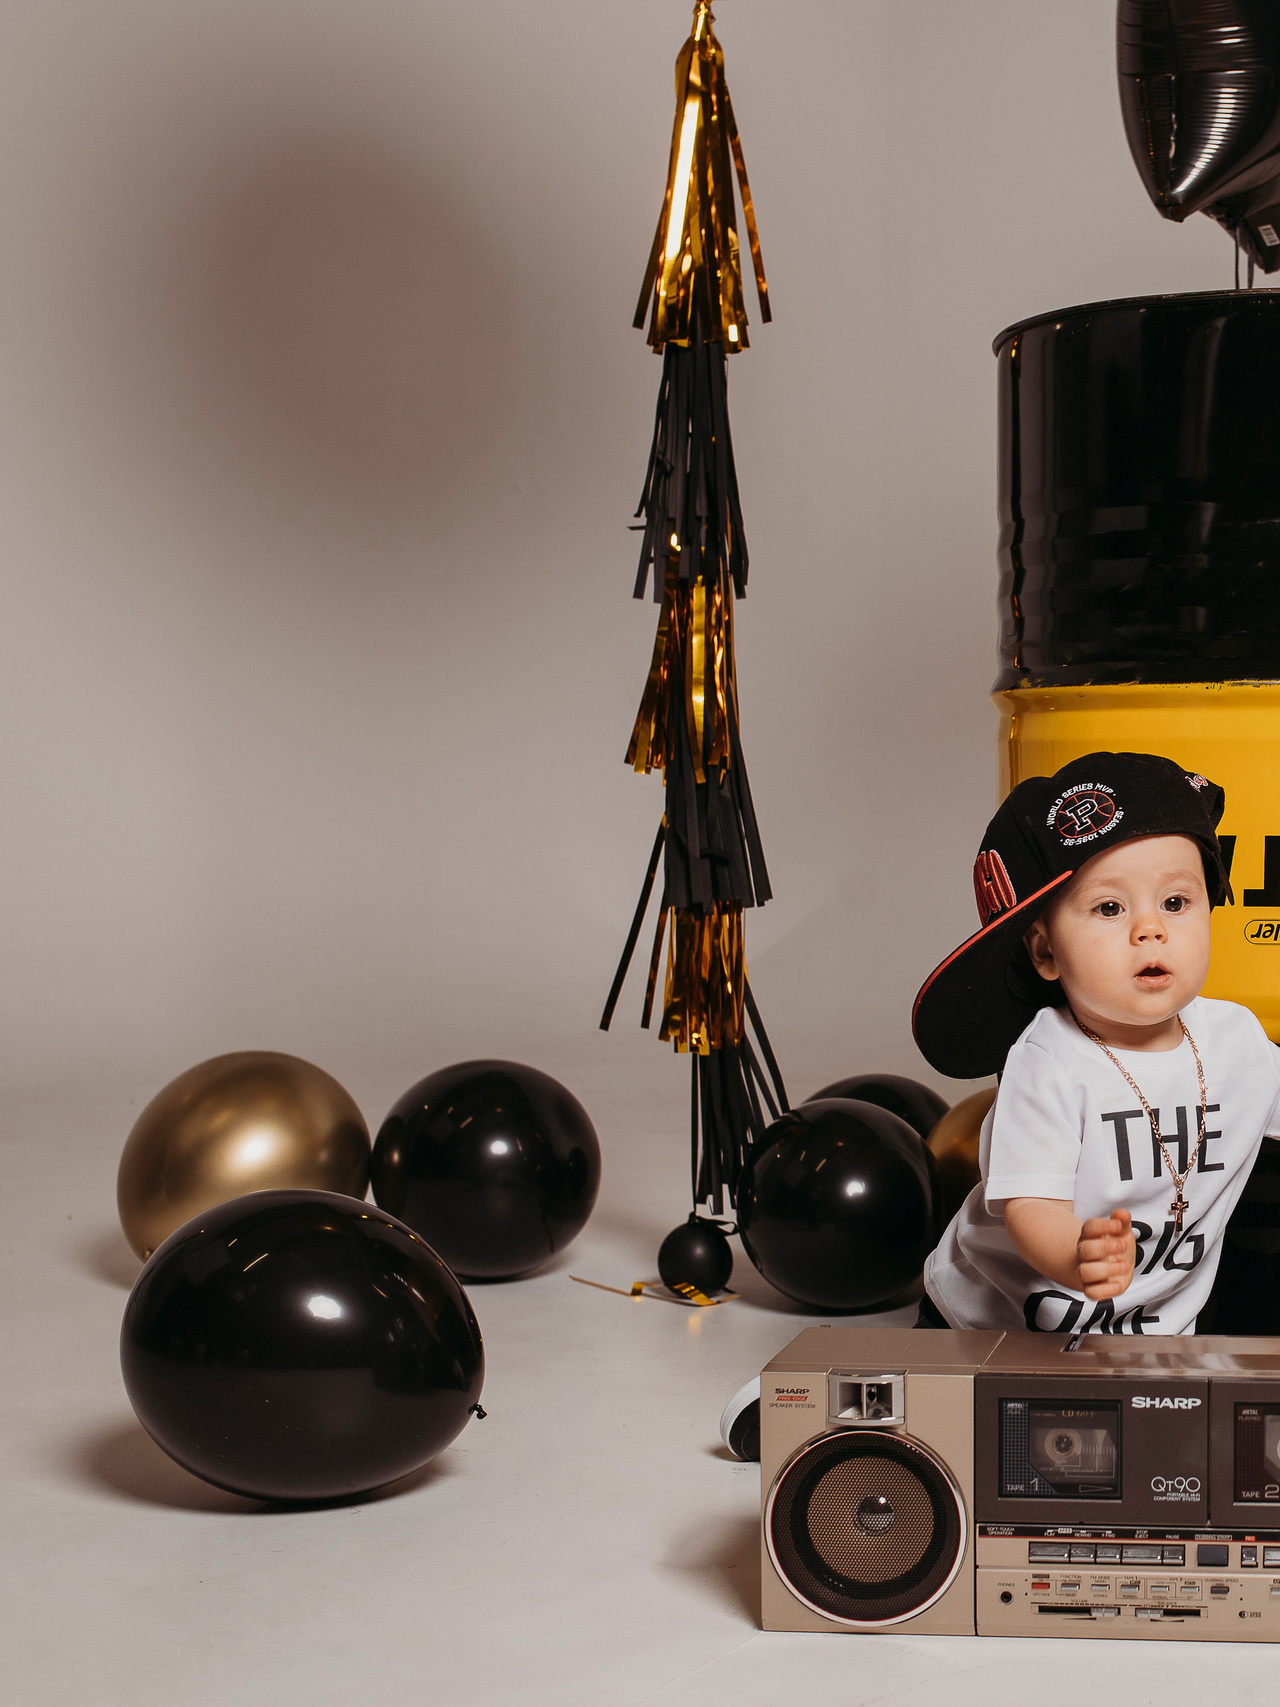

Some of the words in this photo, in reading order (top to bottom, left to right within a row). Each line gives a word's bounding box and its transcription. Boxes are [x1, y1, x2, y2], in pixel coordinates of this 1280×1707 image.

[1046, 798, 1064, 826] WORLD
[1061, 782, 1094, 799] SERIES
[1094, 782, 1114, 794] MVP
[1098, 810, 1124, 835] SEASON
[1101, 1104, 1225, 1181] THE
[1131, 1396, 1202, 1409] SHARP
[1006, 1484, 1025, 1492] TAPE
[1030, 1476, 1039, 1492] 1
[1151, 1476, 1201, 1492] QT90
[1241, 1490, 1260, 1498] TAPE
[1264, 1484, 1280, 1499] 2
